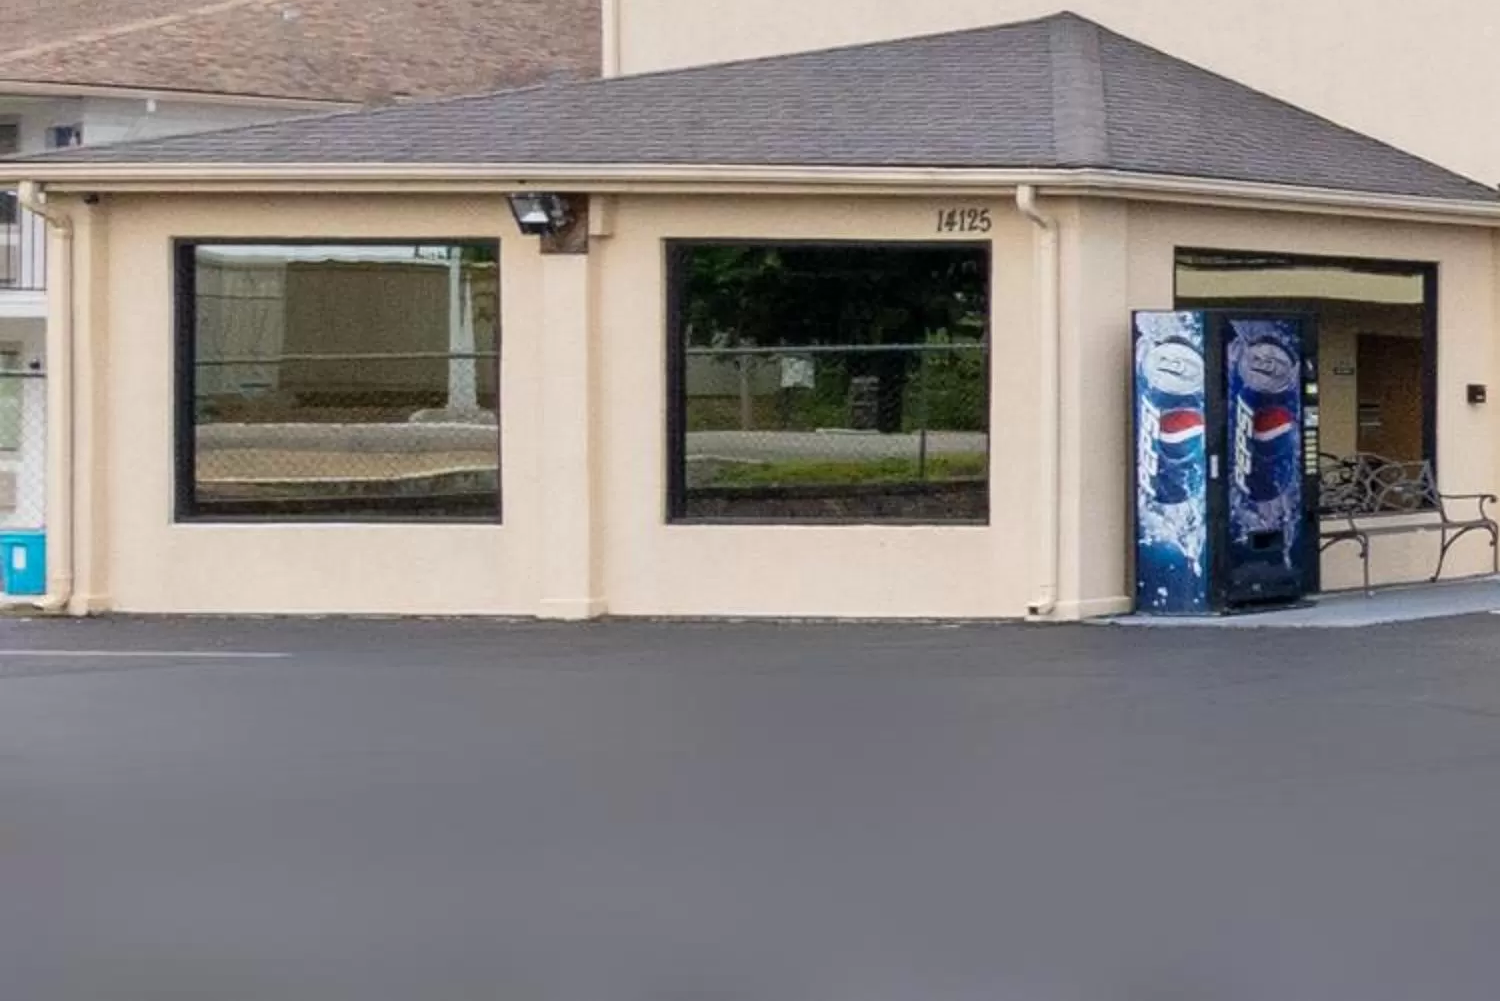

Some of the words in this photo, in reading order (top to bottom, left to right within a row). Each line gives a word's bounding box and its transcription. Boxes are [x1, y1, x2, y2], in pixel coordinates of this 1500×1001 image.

[936, 207, 992, 232] 14125
[1138, 394, 1160, 497] PEPSI
[1234, 394, 1255, 495] PEPSI
